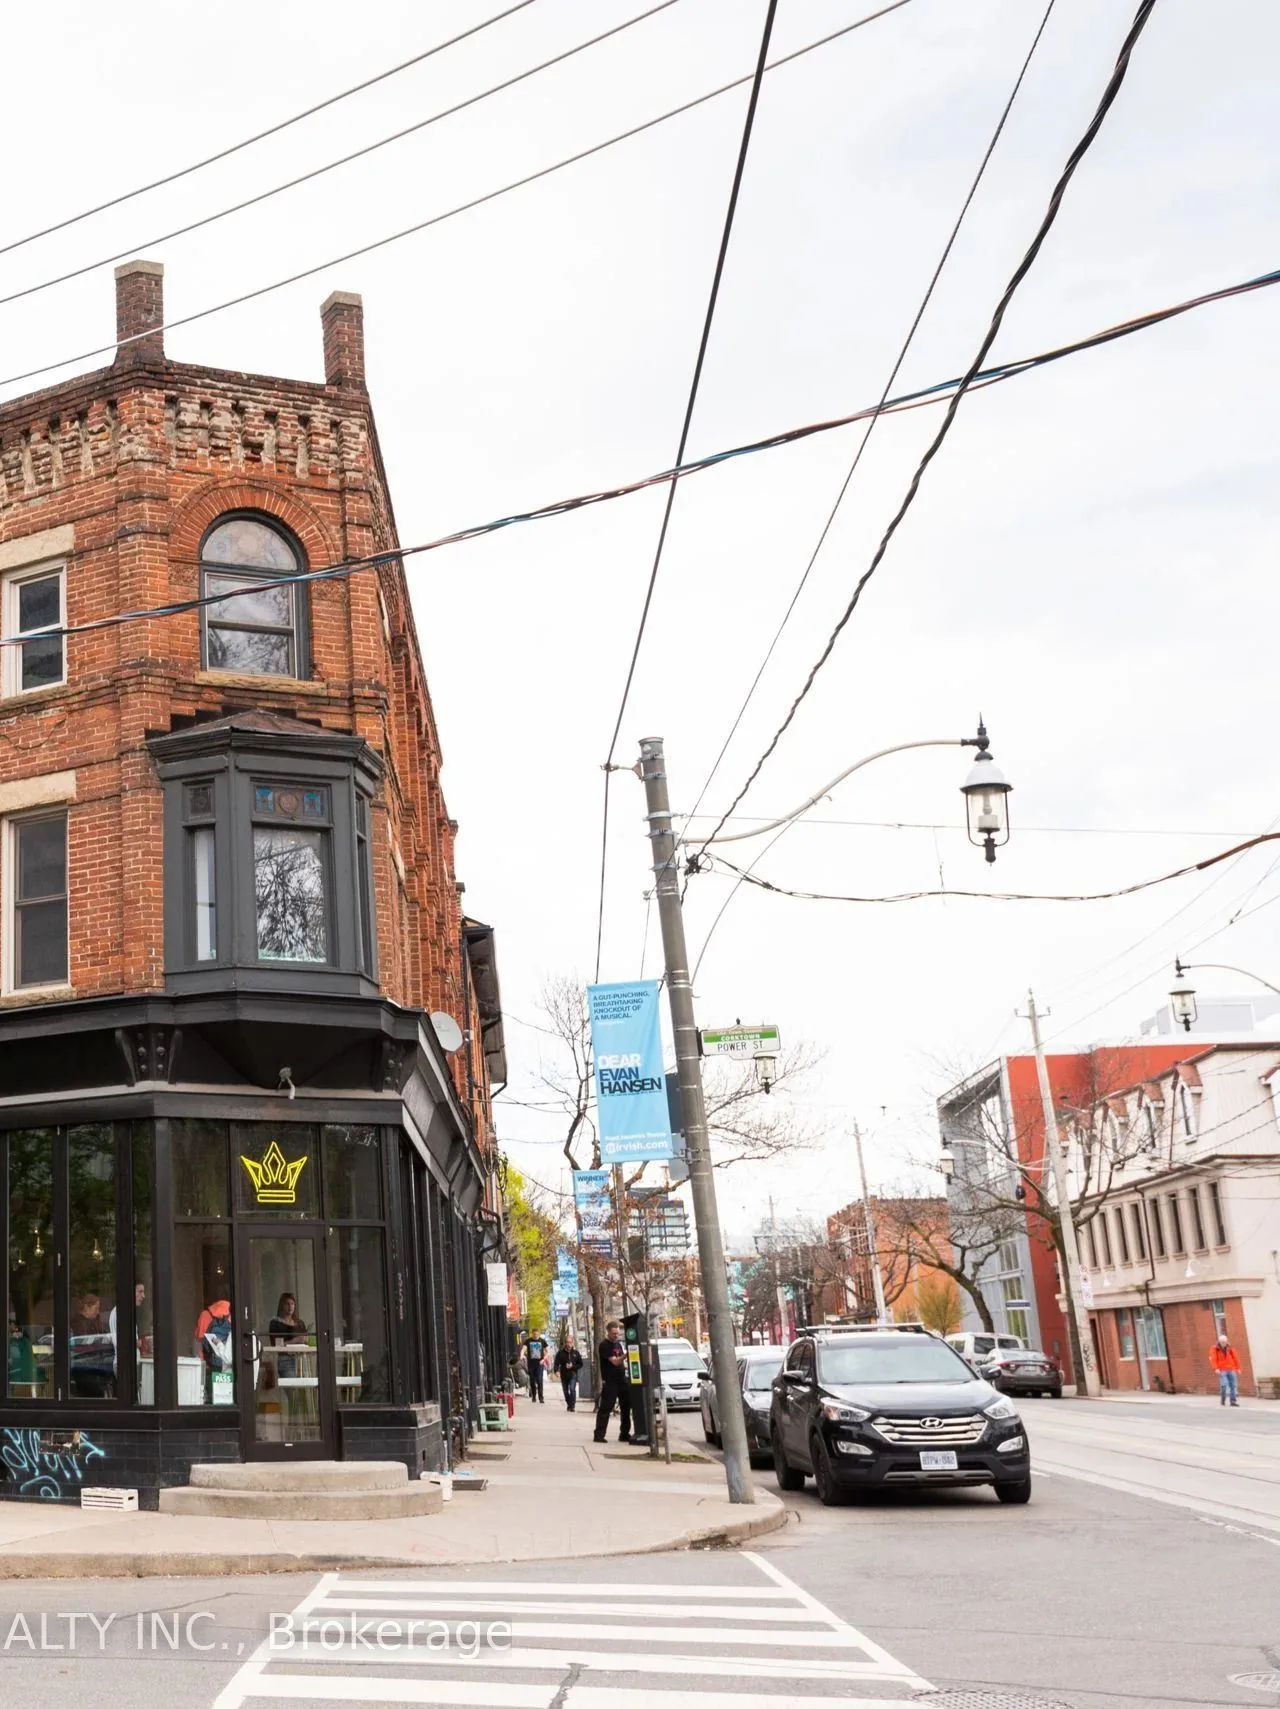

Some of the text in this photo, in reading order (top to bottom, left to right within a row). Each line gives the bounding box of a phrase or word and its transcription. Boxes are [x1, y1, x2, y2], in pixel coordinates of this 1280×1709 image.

[593, 998, 644, 1008] BREATHTAKING
[594, 1005, 631, 1015] KNOCKOUT
[720, 1033, 761, 1042] CORKTOWN
[717, 1040, 764, 1052] POWER ST
[598, 1053, 642, 1069] DEAR
[599, 1066, 640, 1081] EVAN
[600, 1077, 662, 1095] HANSEN
[215, 1374, 231, 1383] PASS
